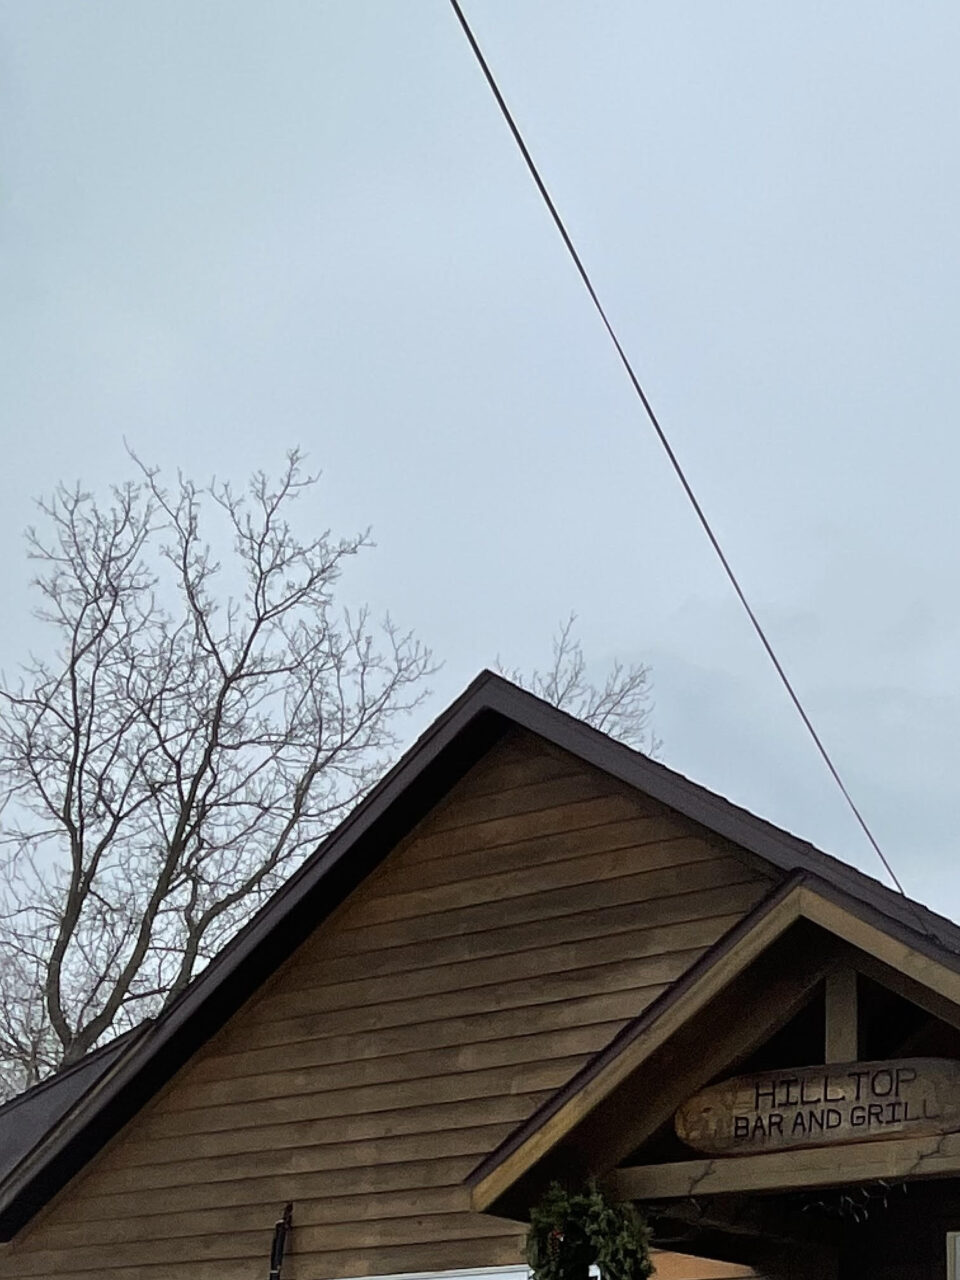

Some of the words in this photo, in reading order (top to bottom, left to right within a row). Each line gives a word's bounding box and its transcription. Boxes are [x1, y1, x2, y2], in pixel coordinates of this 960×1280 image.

[733, 1113, 784, 1139] BAR
[791, 1108, 842, 1133] AND
[850, 1099, 940, 1127] GRILL
